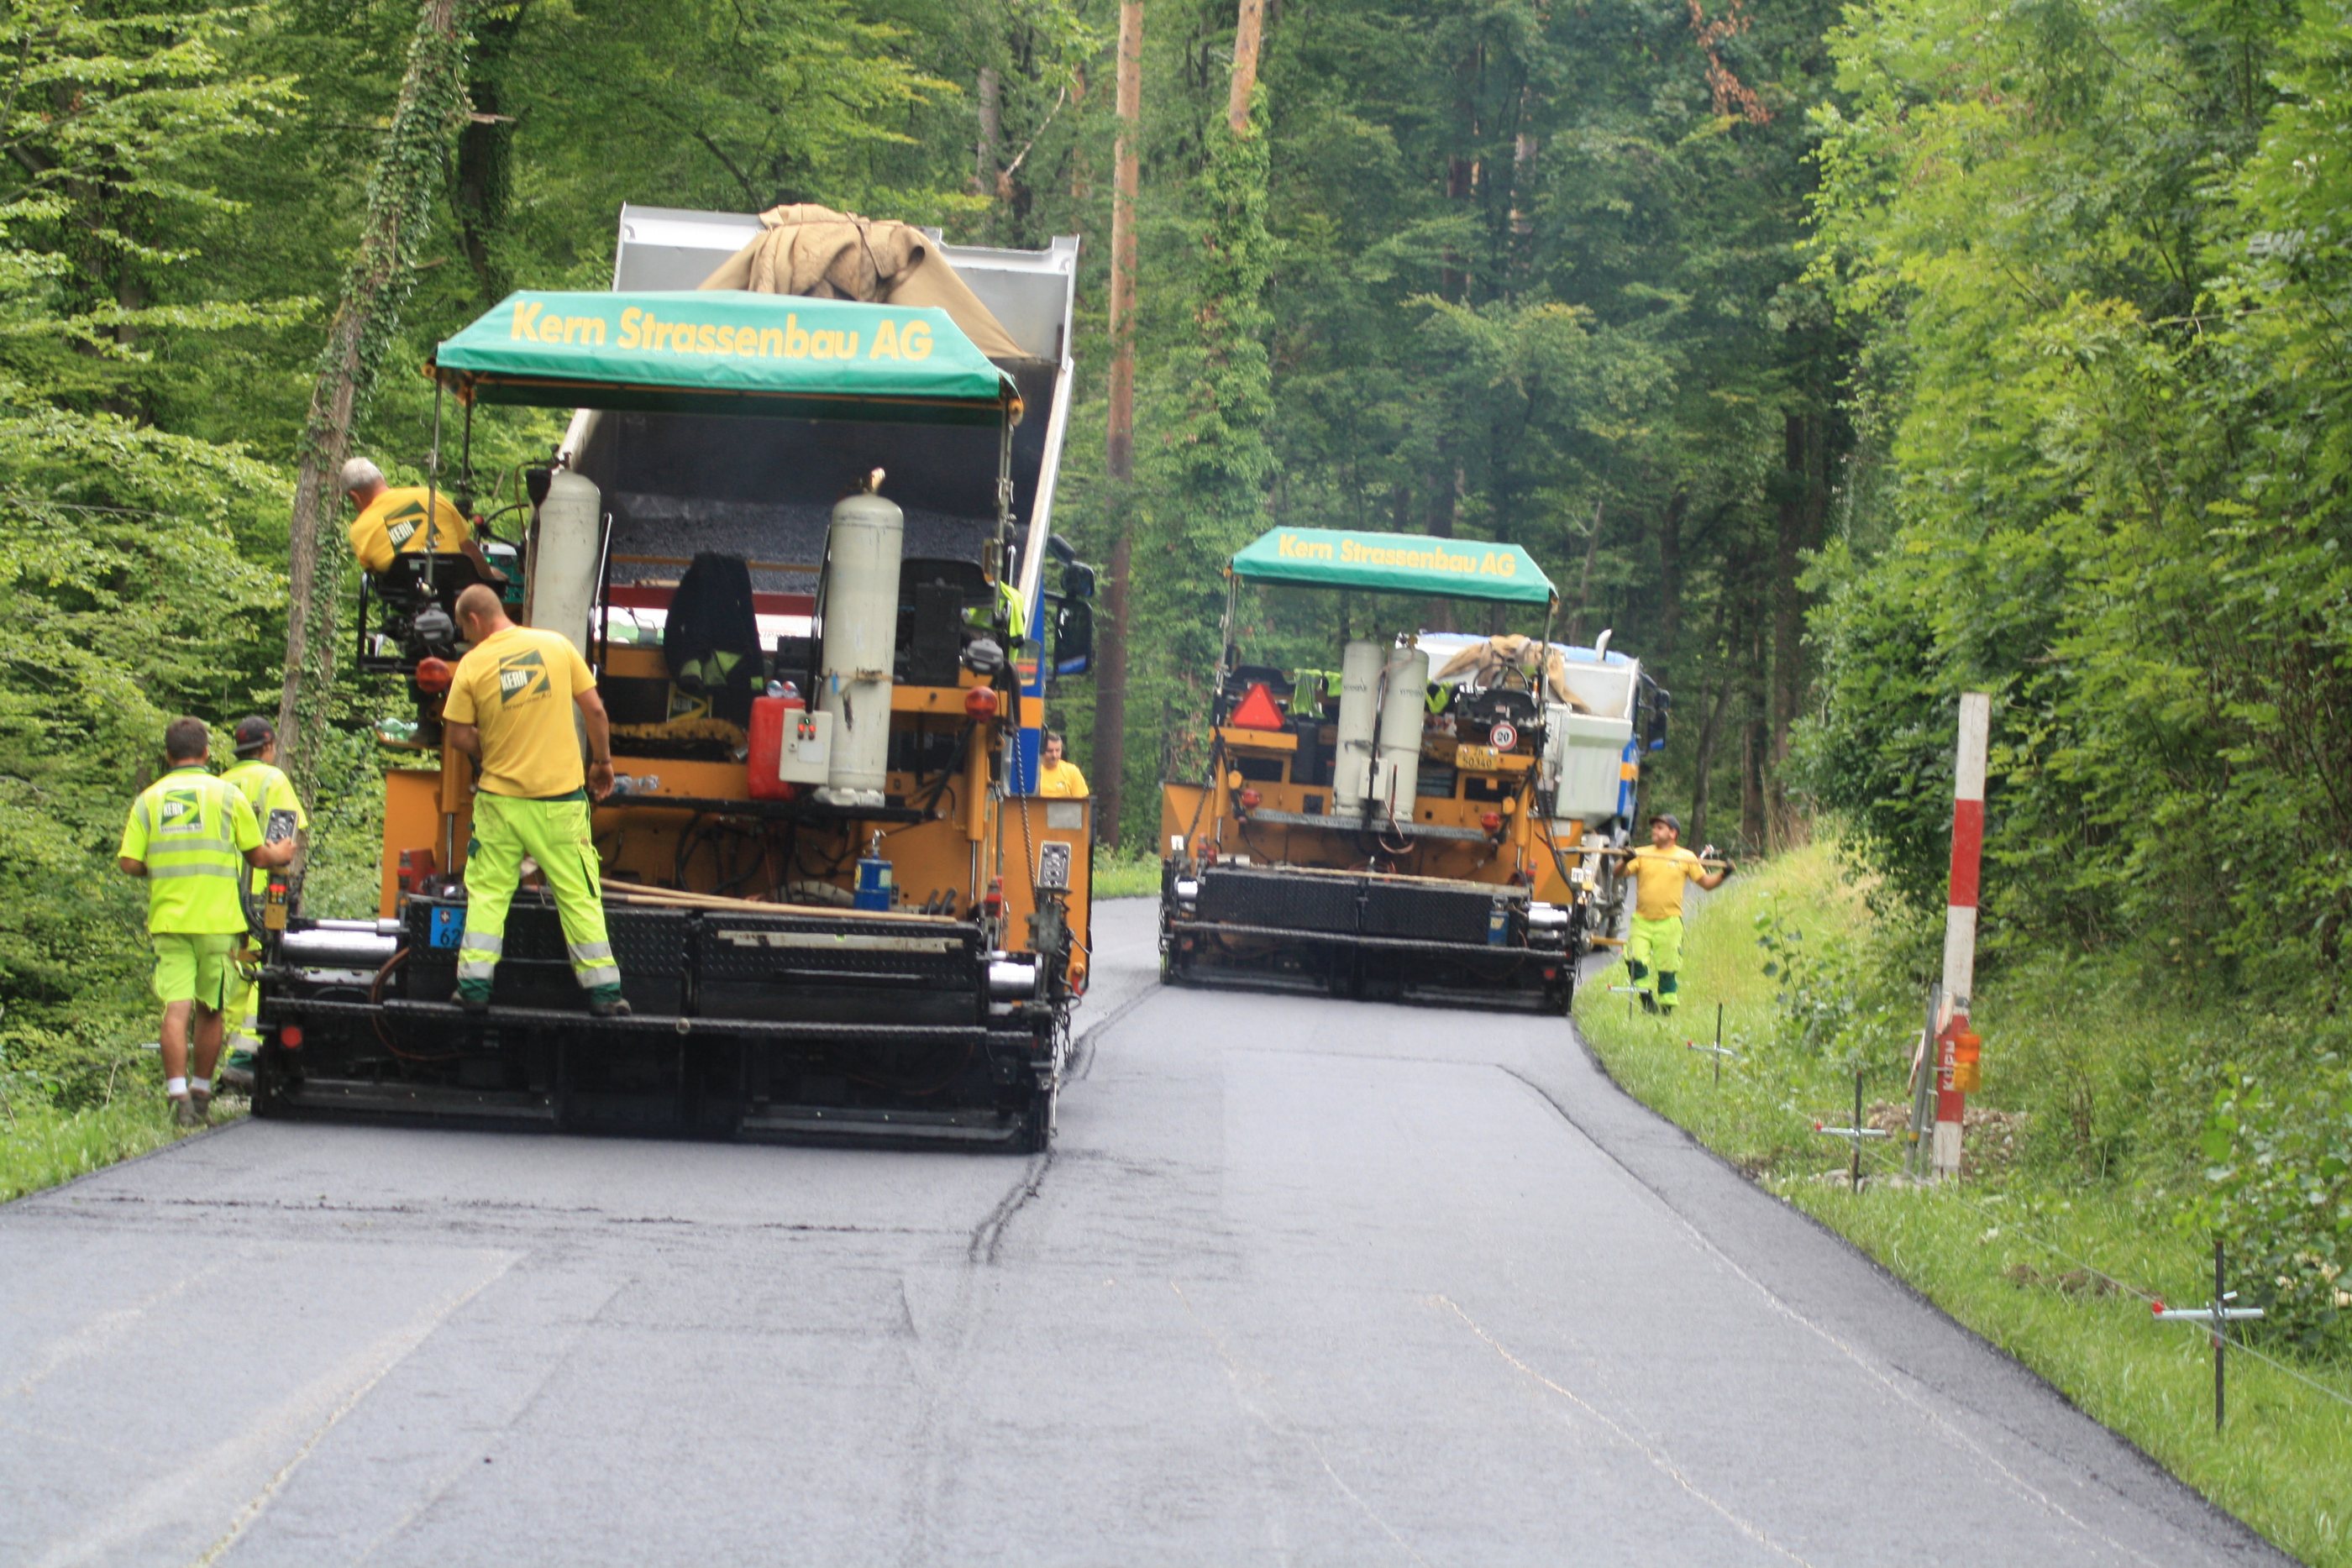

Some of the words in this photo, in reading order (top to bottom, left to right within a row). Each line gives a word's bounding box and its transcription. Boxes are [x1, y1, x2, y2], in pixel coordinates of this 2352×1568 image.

[511, 301, 606, 346] Kern
[617, 306, 859, 361] Strassenbau
[869, 319, 934, 361] AG
[387, 519, 416, 546] KERN
[1278, 533, 1333, 559] Kern
[1340, 538, 1478, 574] Strassenbau
[1479, 551, 1517, 578] AG
[500, 669, 528, 692] KERN
[1497, 731, 1510, 742] 20
[163, 801, 184, 817] KERN
[439, 927, 464, 947] 62
